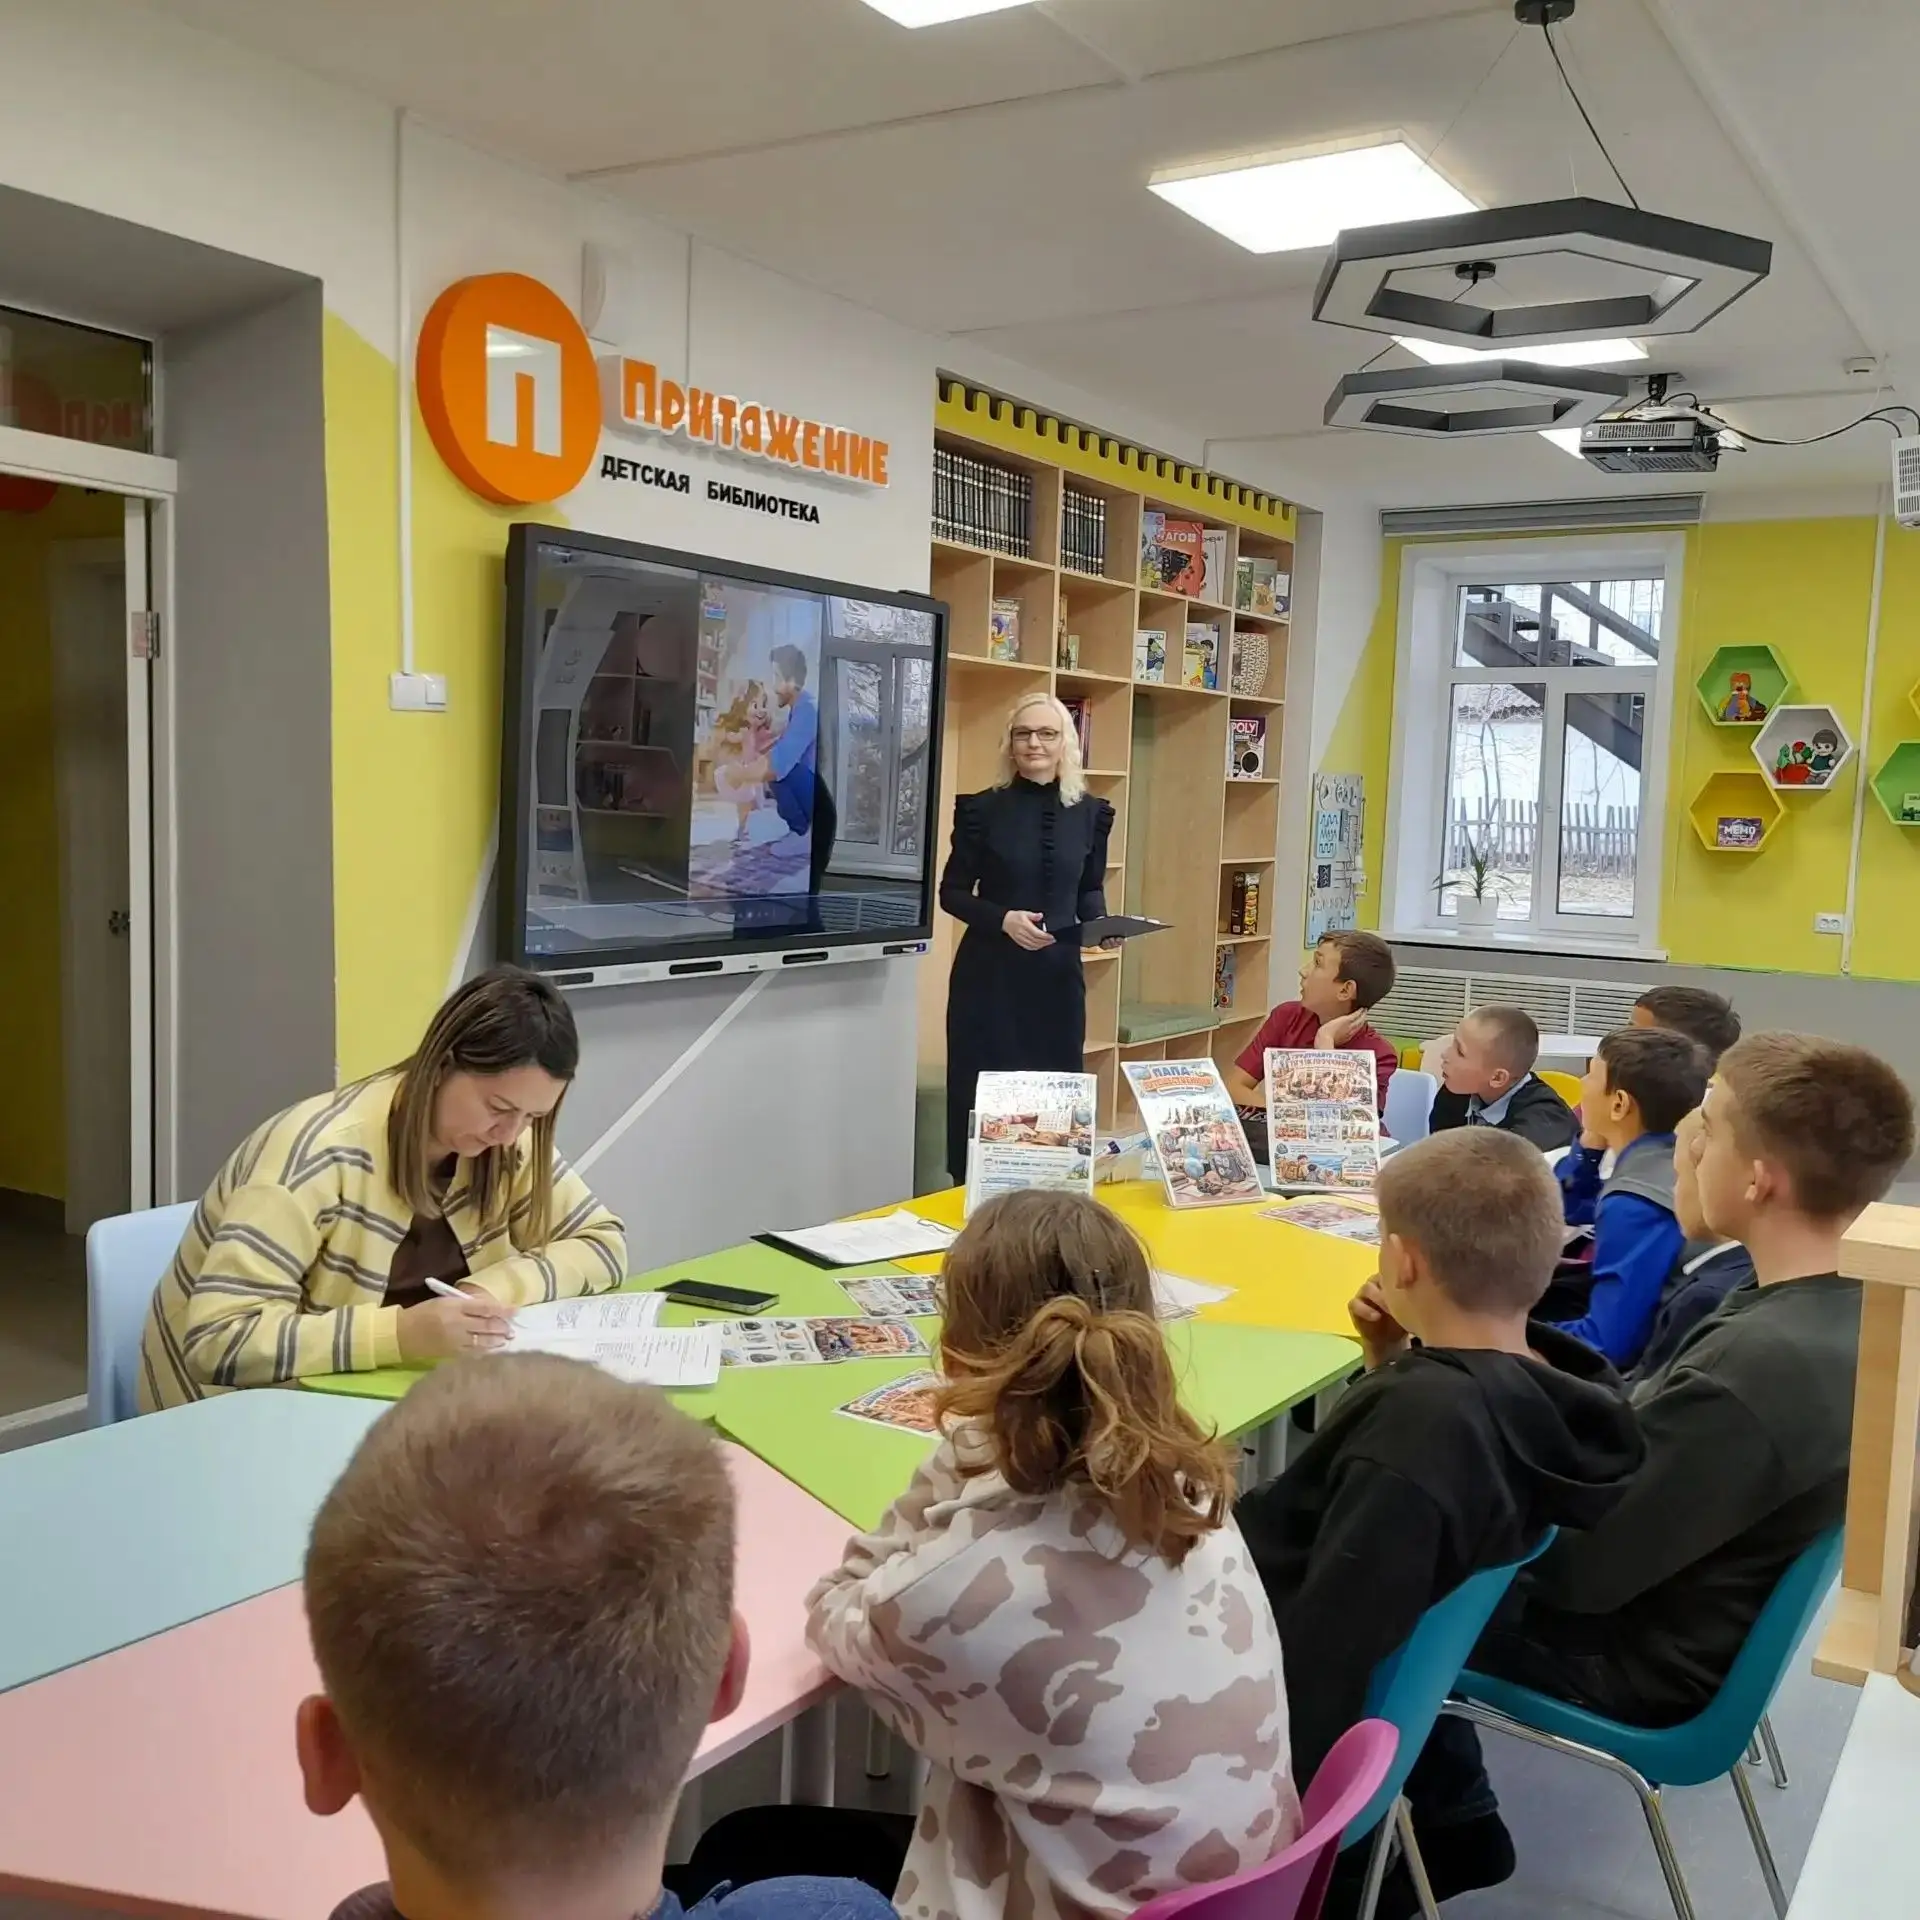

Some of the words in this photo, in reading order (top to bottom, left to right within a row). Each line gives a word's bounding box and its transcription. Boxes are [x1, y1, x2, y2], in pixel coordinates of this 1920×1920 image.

[485, 322, 562, 458] П
[622, 357, 890, 486] ПРИТЯЖЕНИЕ
[601, 454, 690, 494] ДЕТСКАЯ
[707, 481, 820, 525] БИБЛИОТЕКА
